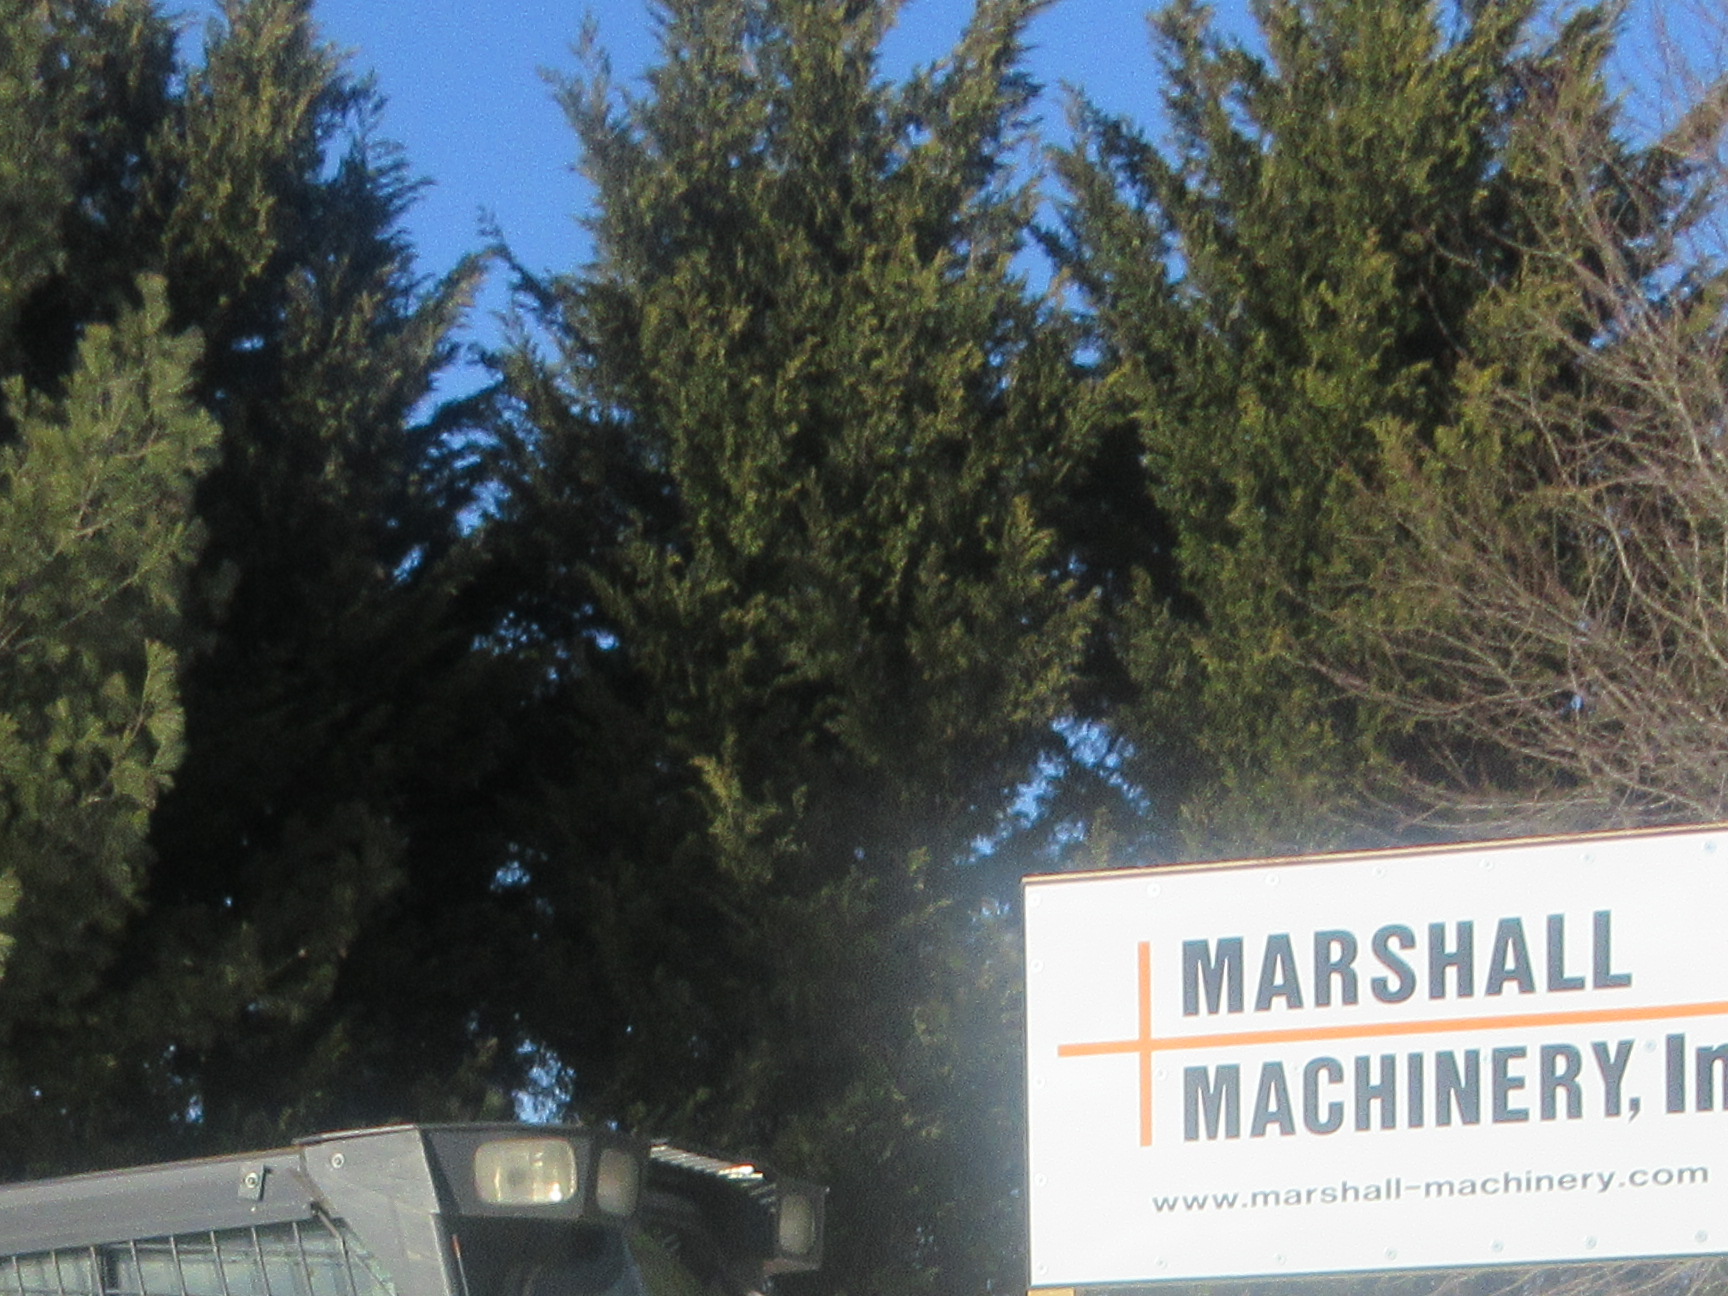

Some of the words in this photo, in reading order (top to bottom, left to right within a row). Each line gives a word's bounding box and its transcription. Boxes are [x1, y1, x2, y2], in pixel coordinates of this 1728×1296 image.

[1181, 910, 1634, 1018] MARSHALL
[1182, 1039, 1643, 1144] MACHINERY,
[1152, 1166, 1710, 1213] www.marshall-machinery.com
